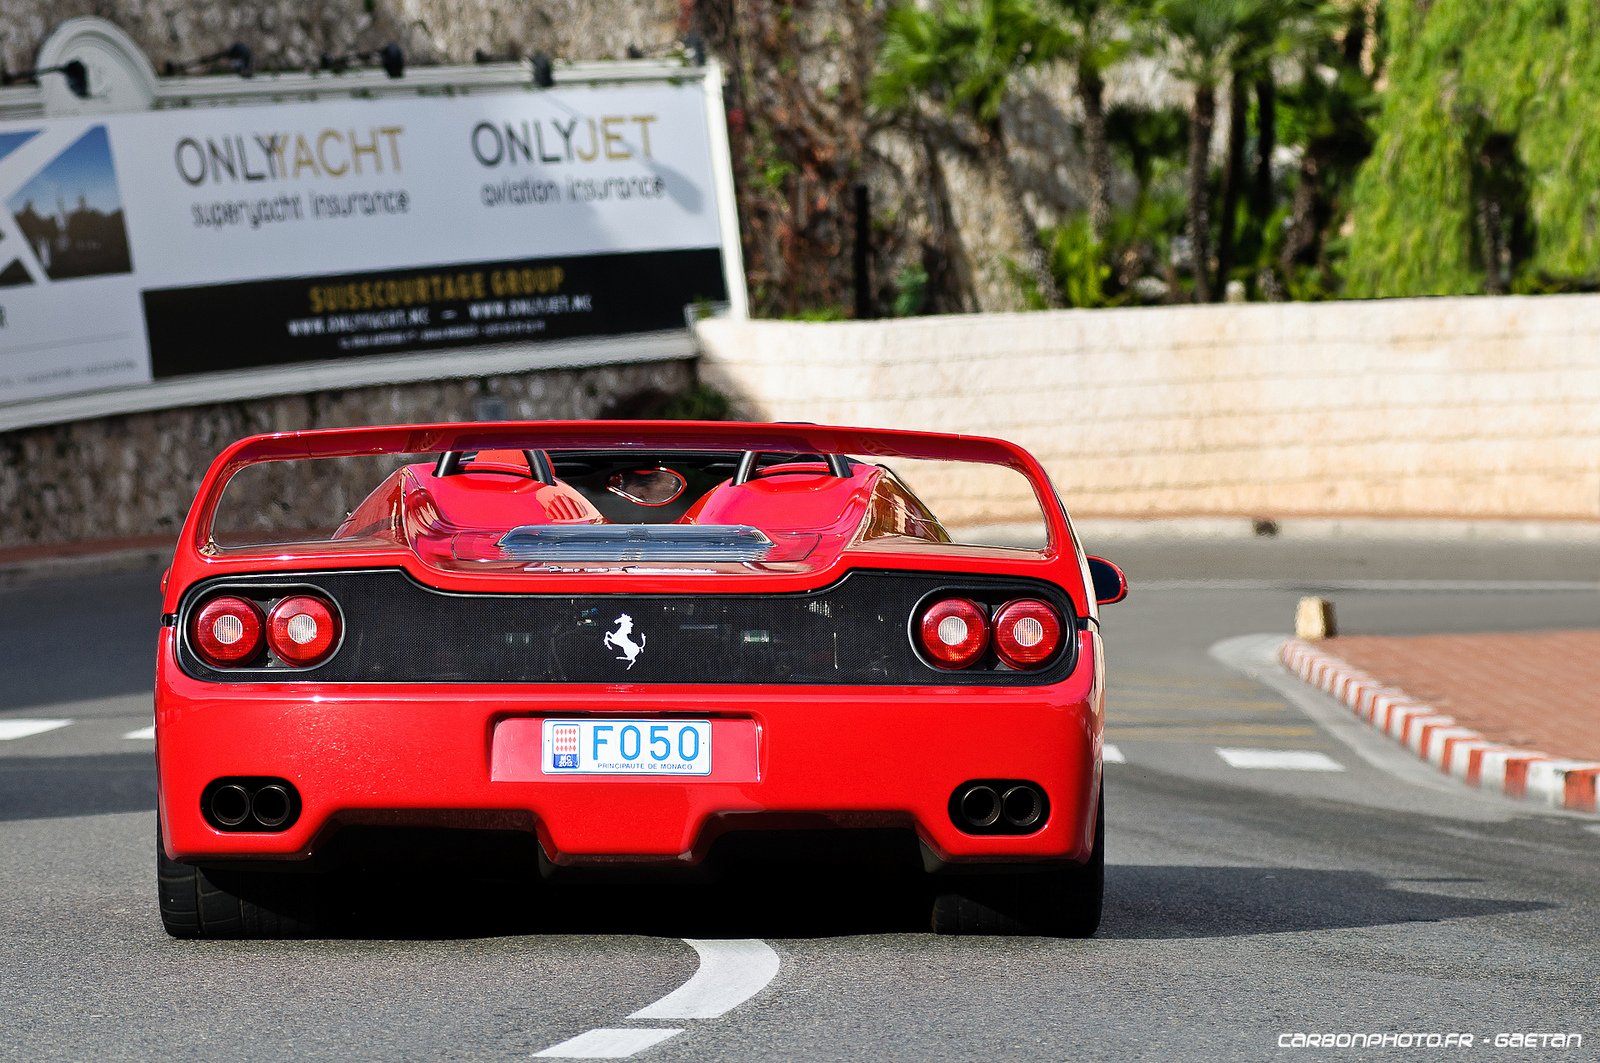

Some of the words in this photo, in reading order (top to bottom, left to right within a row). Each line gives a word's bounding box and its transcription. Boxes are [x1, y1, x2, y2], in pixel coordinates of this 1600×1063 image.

[174, 125, 404, 187] ONLYYACHT
[471, 114, 657, 169] ONLYJET
[191, 192, 303, 230] superyacht
[310, 190, 410, 219] insurance
[481, 176, 560, 207] aviation
[567, 174, 665, 201] insurance
[309, 271, 486, 313] SUISSCOURTAGE
[490, 265, 565, 297] GROUP
